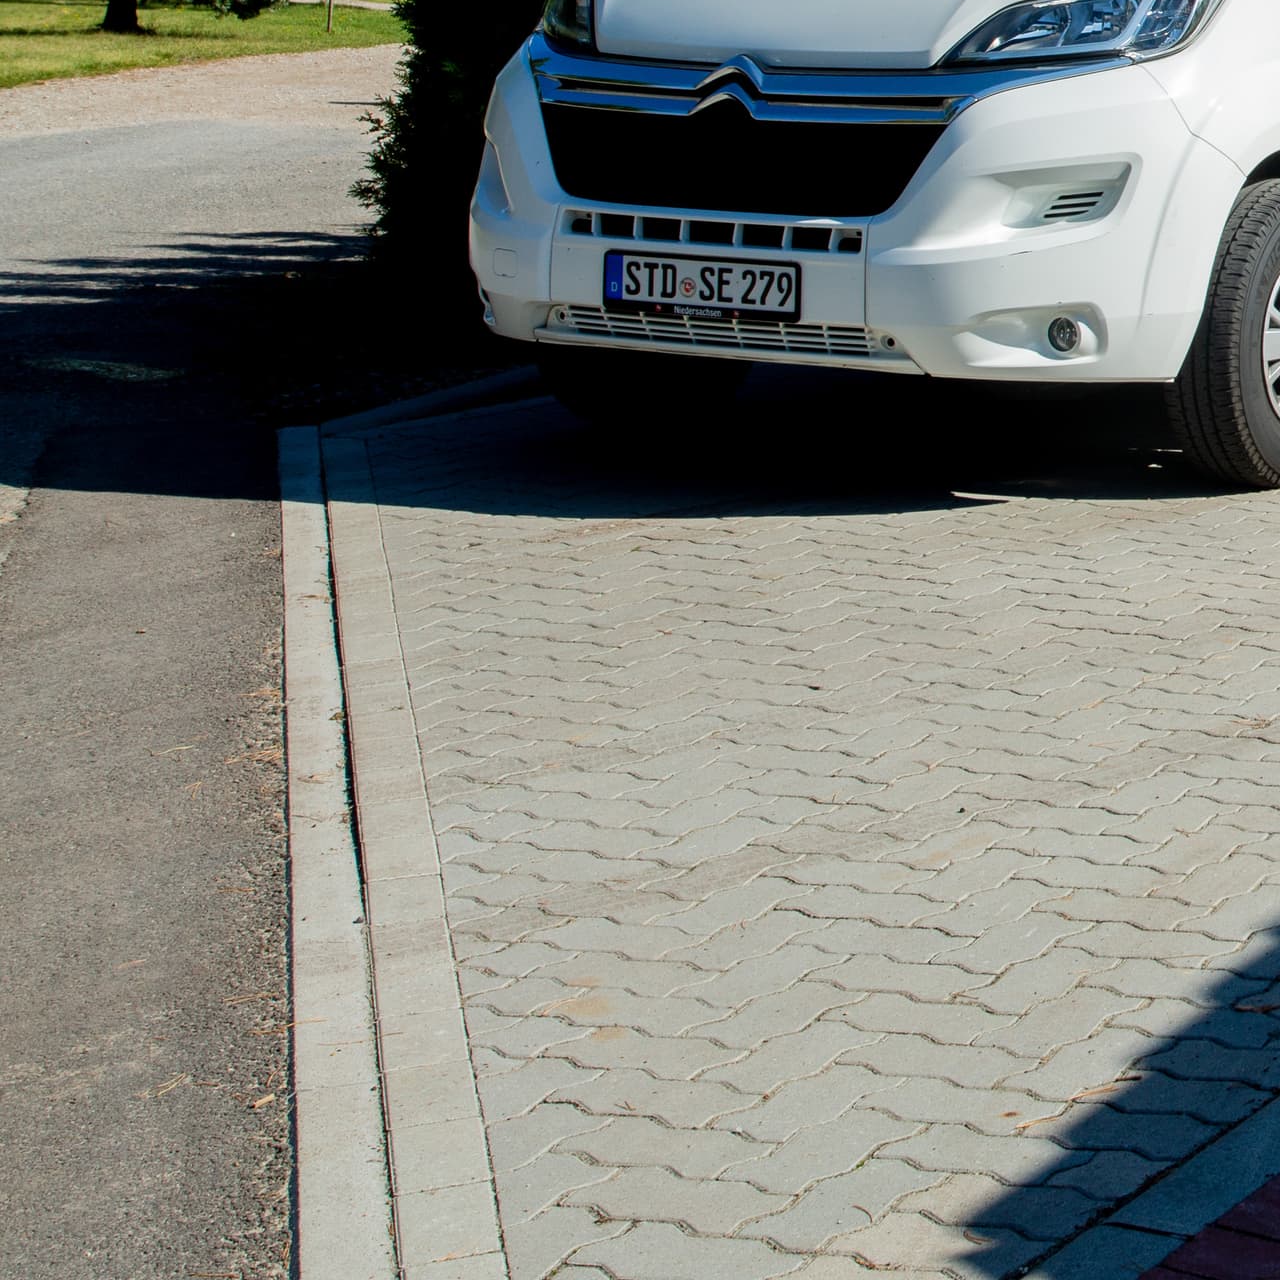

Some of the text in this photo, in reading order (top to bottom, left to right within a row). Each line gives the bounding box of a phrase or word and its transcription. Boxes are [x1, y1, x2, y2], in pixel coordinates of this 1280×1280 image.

[611, 261, 793, 307] D STD SE 279
[673, 305, 722, 318] Niedersachsen
